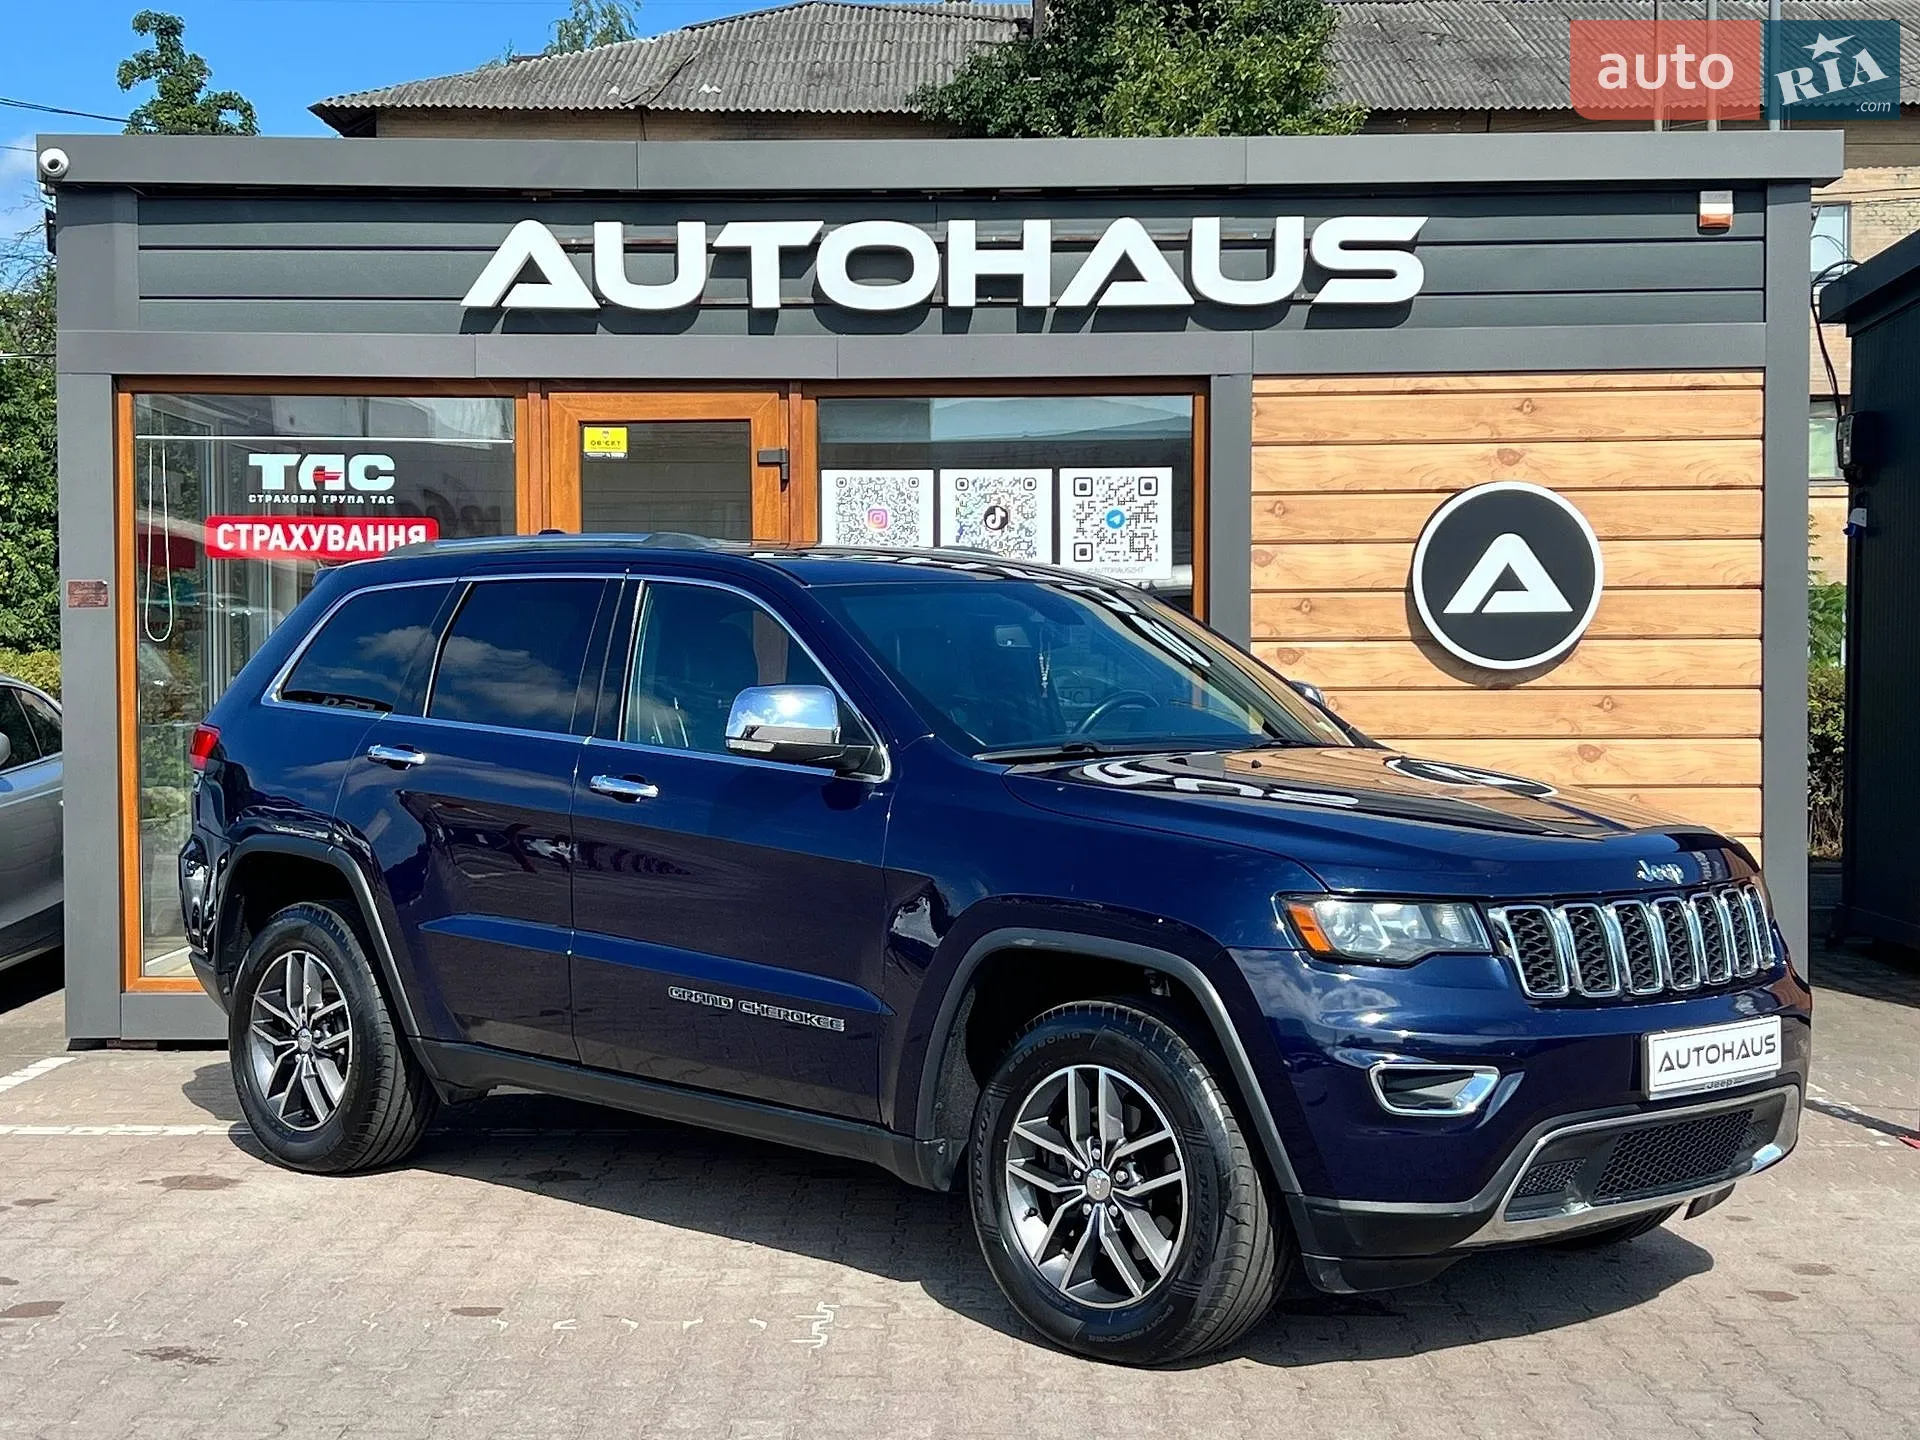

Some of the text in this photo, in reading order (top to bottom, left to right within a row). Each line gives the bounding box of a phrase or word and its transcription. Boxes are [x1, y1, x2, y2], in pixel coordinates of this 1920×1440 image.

[460, 216, 1429, 311] AUTOHAUS
[248, 494, 395, 504] СТРАХОВА ГРУПА ТАС
[216, 523, 427, 552] СТРАХУВАННЯ
[1636, 859, 1684, 885] Jeep
[668, 986, 845, 1032] GRAND CHEROKEE
[1658, 1033, 1777, 1073] AUTOHAUS
[1706, 1078, 1734, 1090] Jeep
